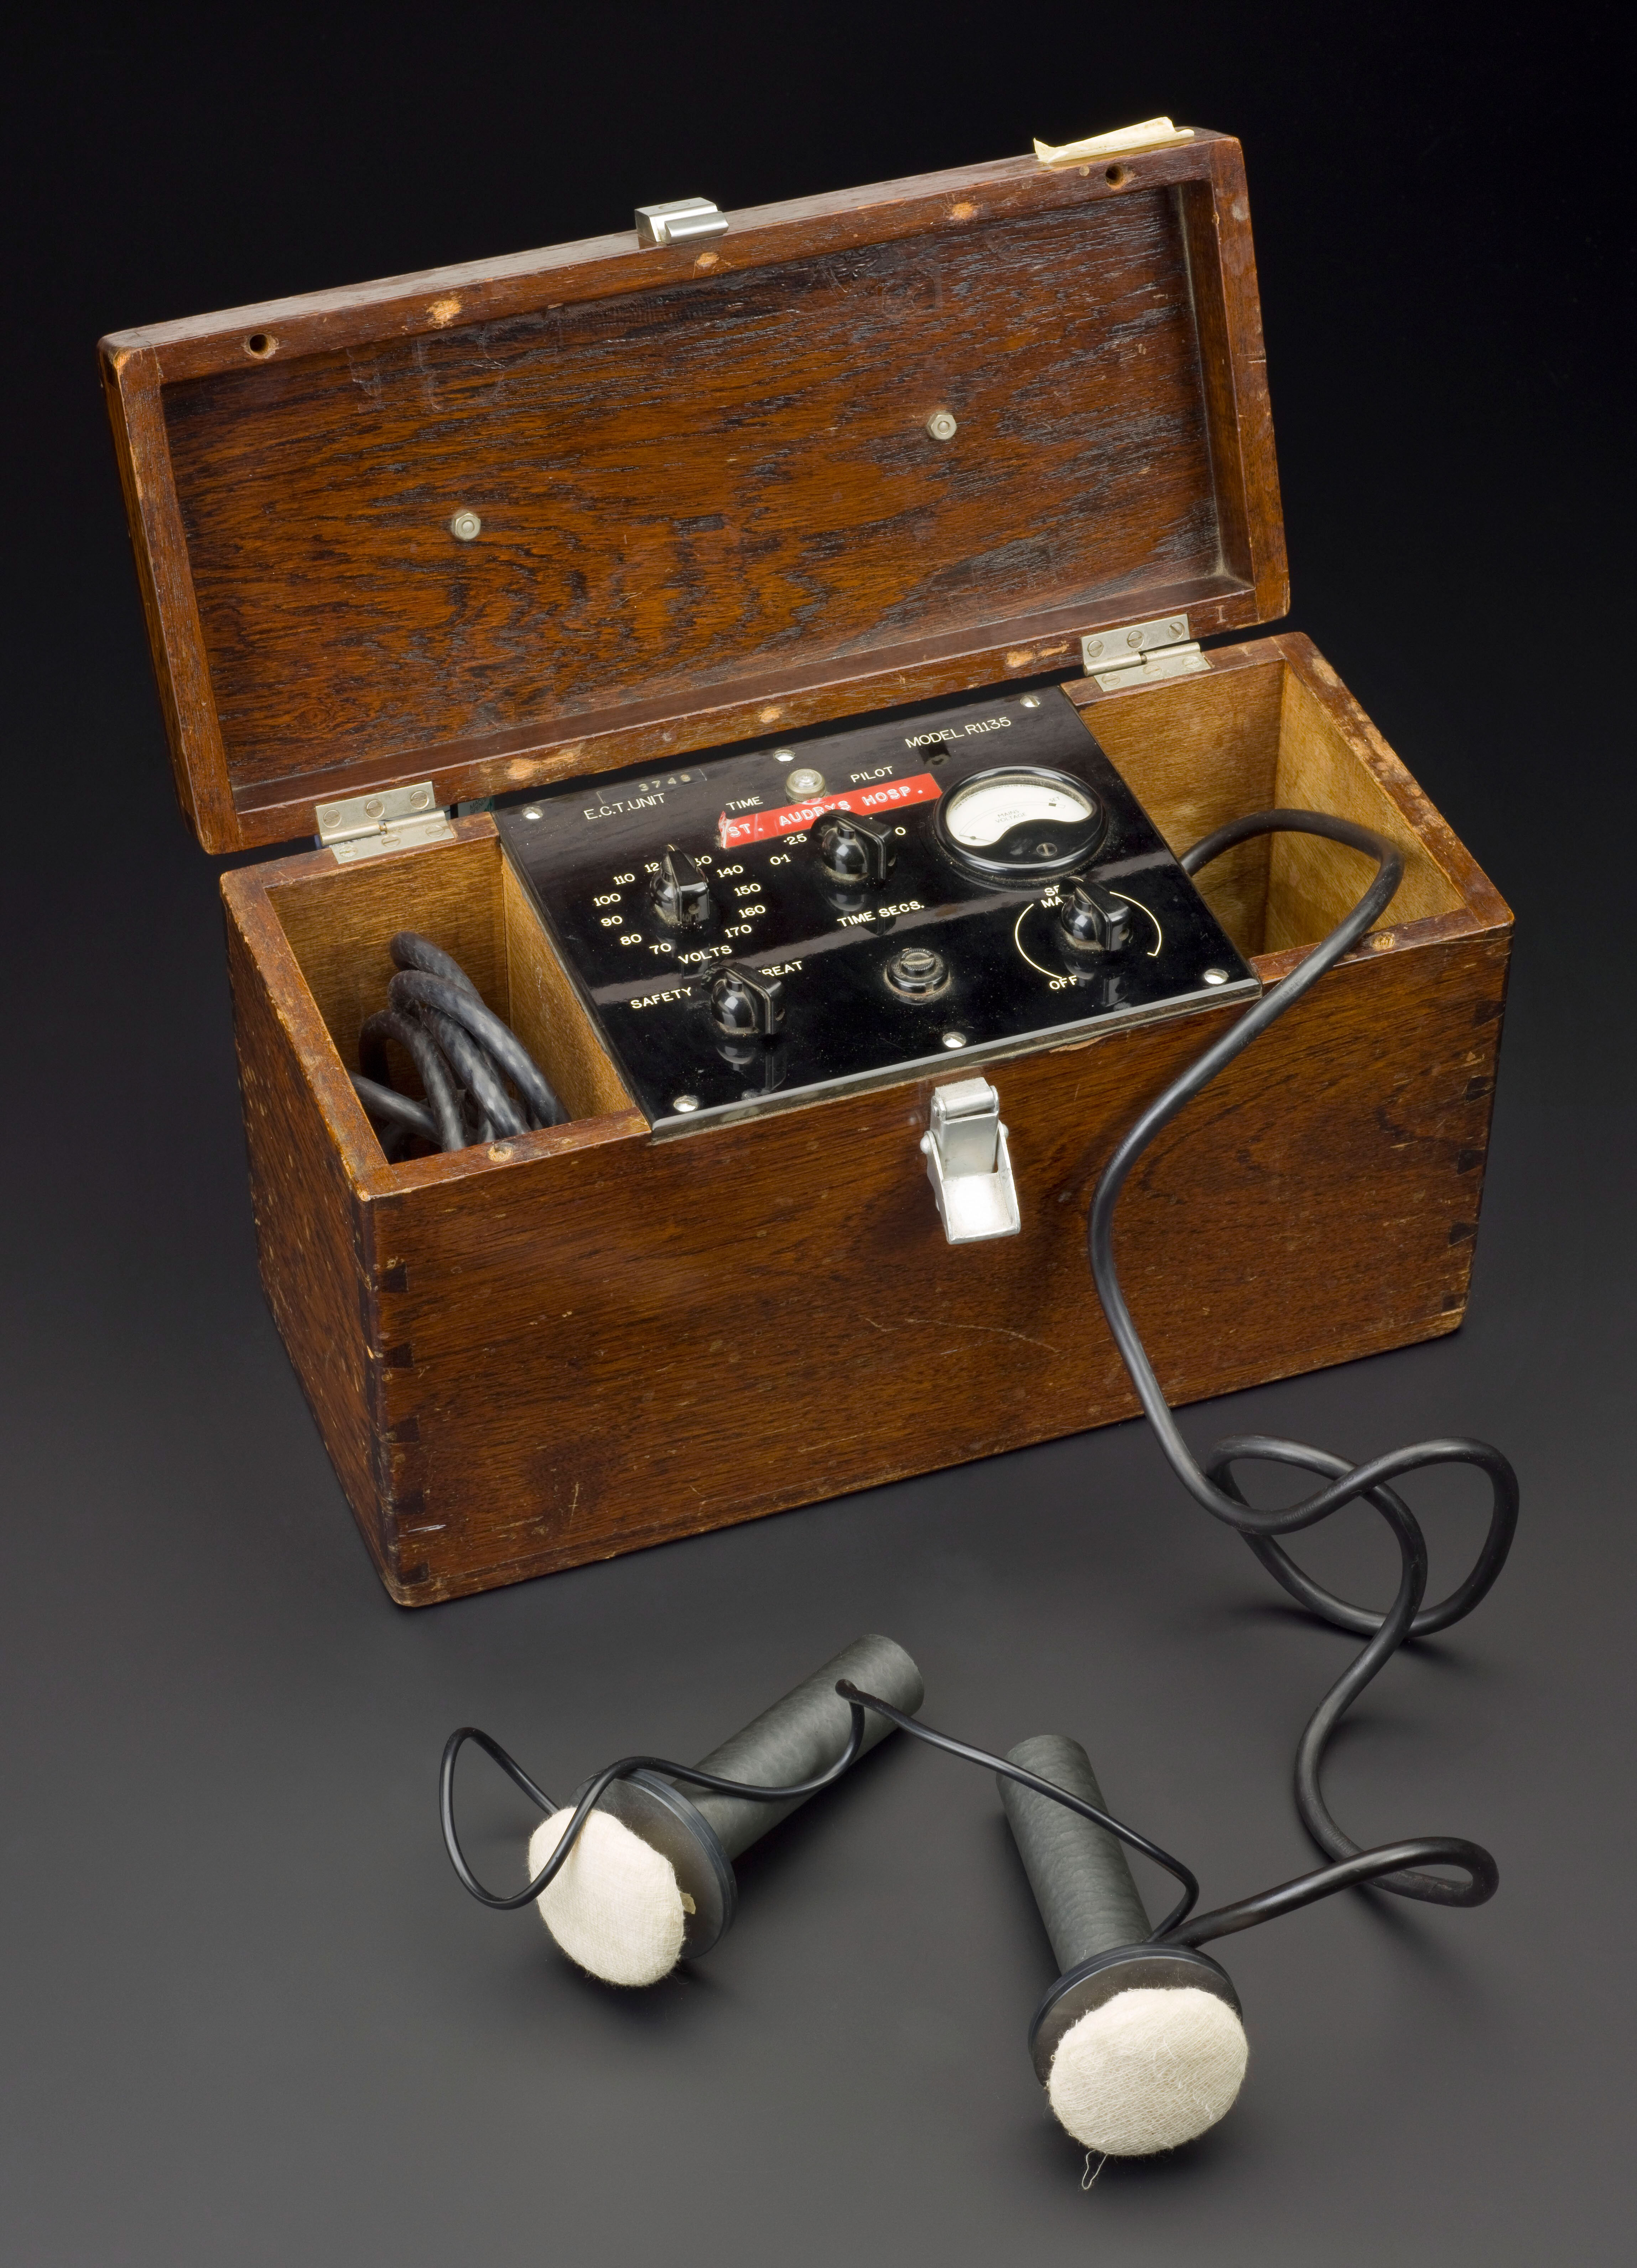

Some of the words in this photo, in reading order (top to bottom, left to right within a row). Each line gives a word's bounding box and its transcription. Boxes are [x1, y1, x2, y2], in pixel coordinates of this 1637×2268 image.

[905, 728, 965, 748] MODEL
[965, 717, 1012, 735] R1135
[850, 766, 893, 783] PILOT
[726, 796, 763, 811] TIME
[779, 801, 852, 827] AUDRYS
[862, 786, 923, 806] HOSP.
[995, 812, 1027, 823] VOLTAGE
[997, 809, 1019, 818] MAINS
[644, 863, 660, 872] 12
[717, 865, 743, 878] 140
[613, 873, 635, 885] 110
[734, 883, 761, 896] 150
[593, 893, 621, 906] 100
[739, 905, 766, 918] 160
[837, 911, 876, 927] TIME
[879, 901, 925, 917] SECS.
[601, 915, 623, 927] 90
[724, 925, 752, 938] 170
[620, 934, 642, 945] 80
[649, 943, 672, 954] 70
[678, 945, 732, 964] VOLTS
[758, 961, 802, 976] REAT
[1049, 975, 1077, 990] OFF
[630, 987, 691, 1009] SAFETY
